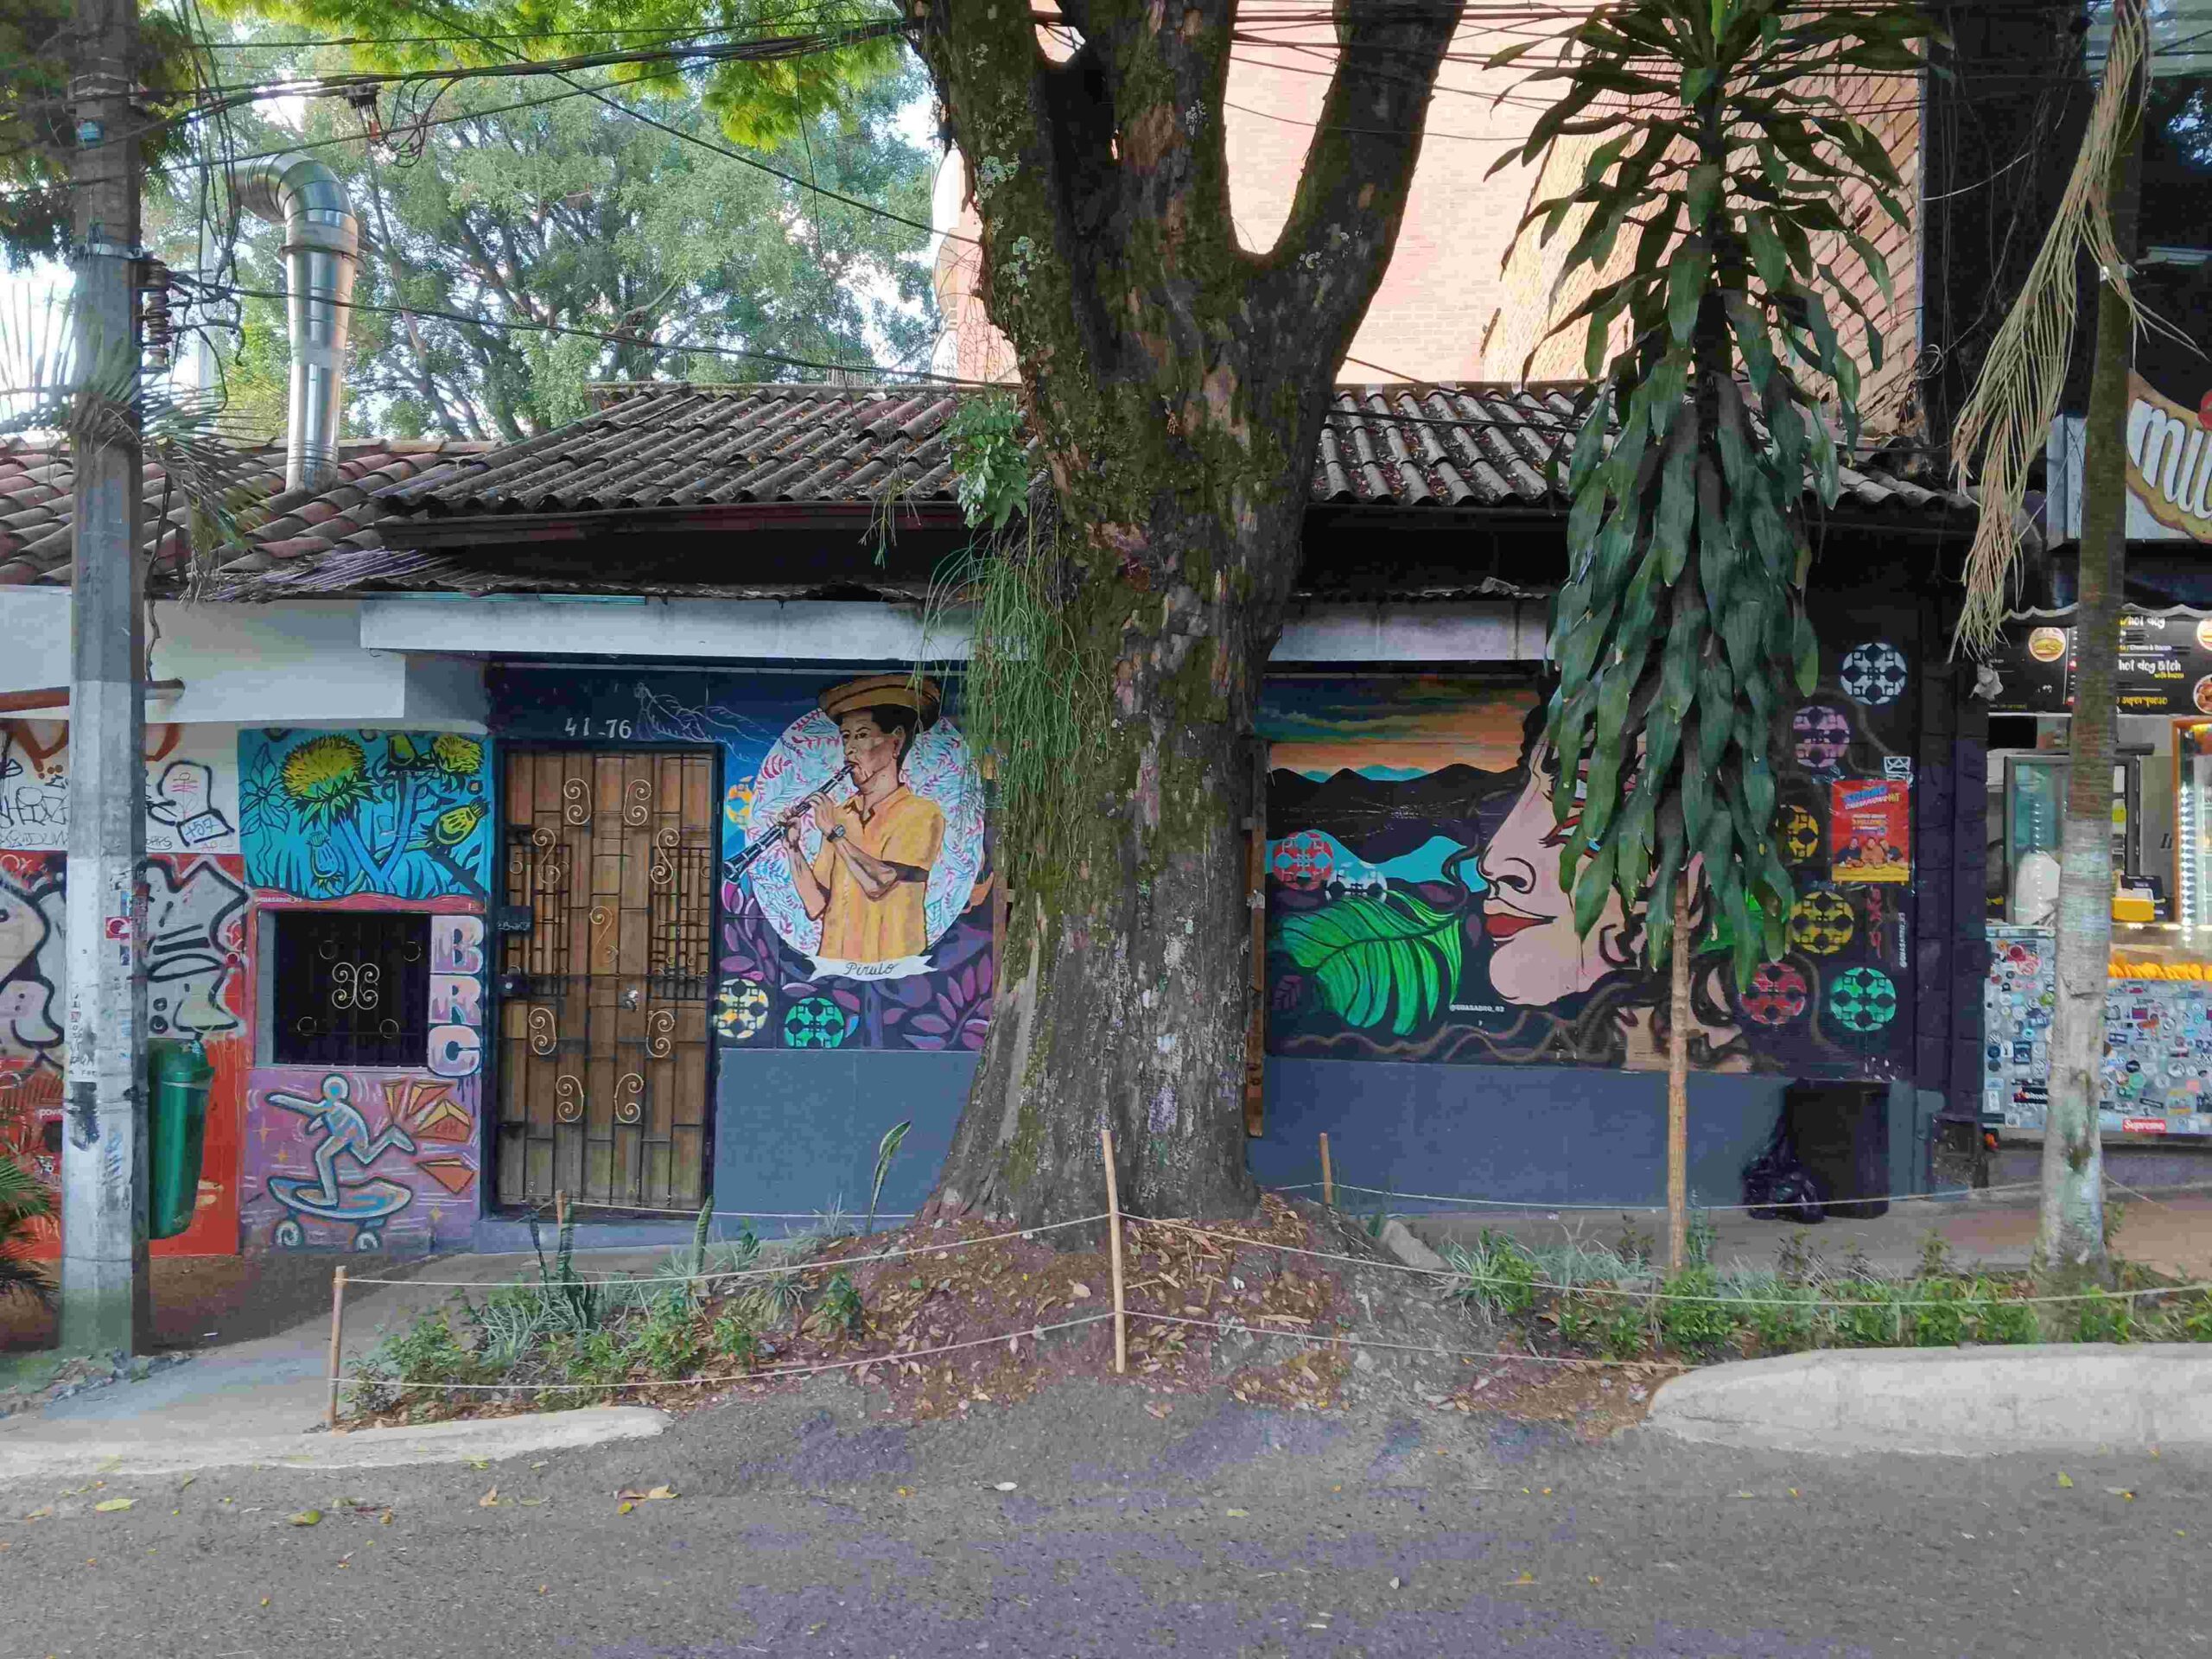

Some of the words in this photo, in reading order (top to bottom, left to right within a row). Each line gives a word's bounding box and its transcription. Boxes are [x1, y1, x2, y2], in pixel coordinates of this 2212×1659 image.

[2118, 659, 2135, 671] hot
[2137, 659, 2156, 674] dog
[2123, 1119, 2165, 1132] Supreme
